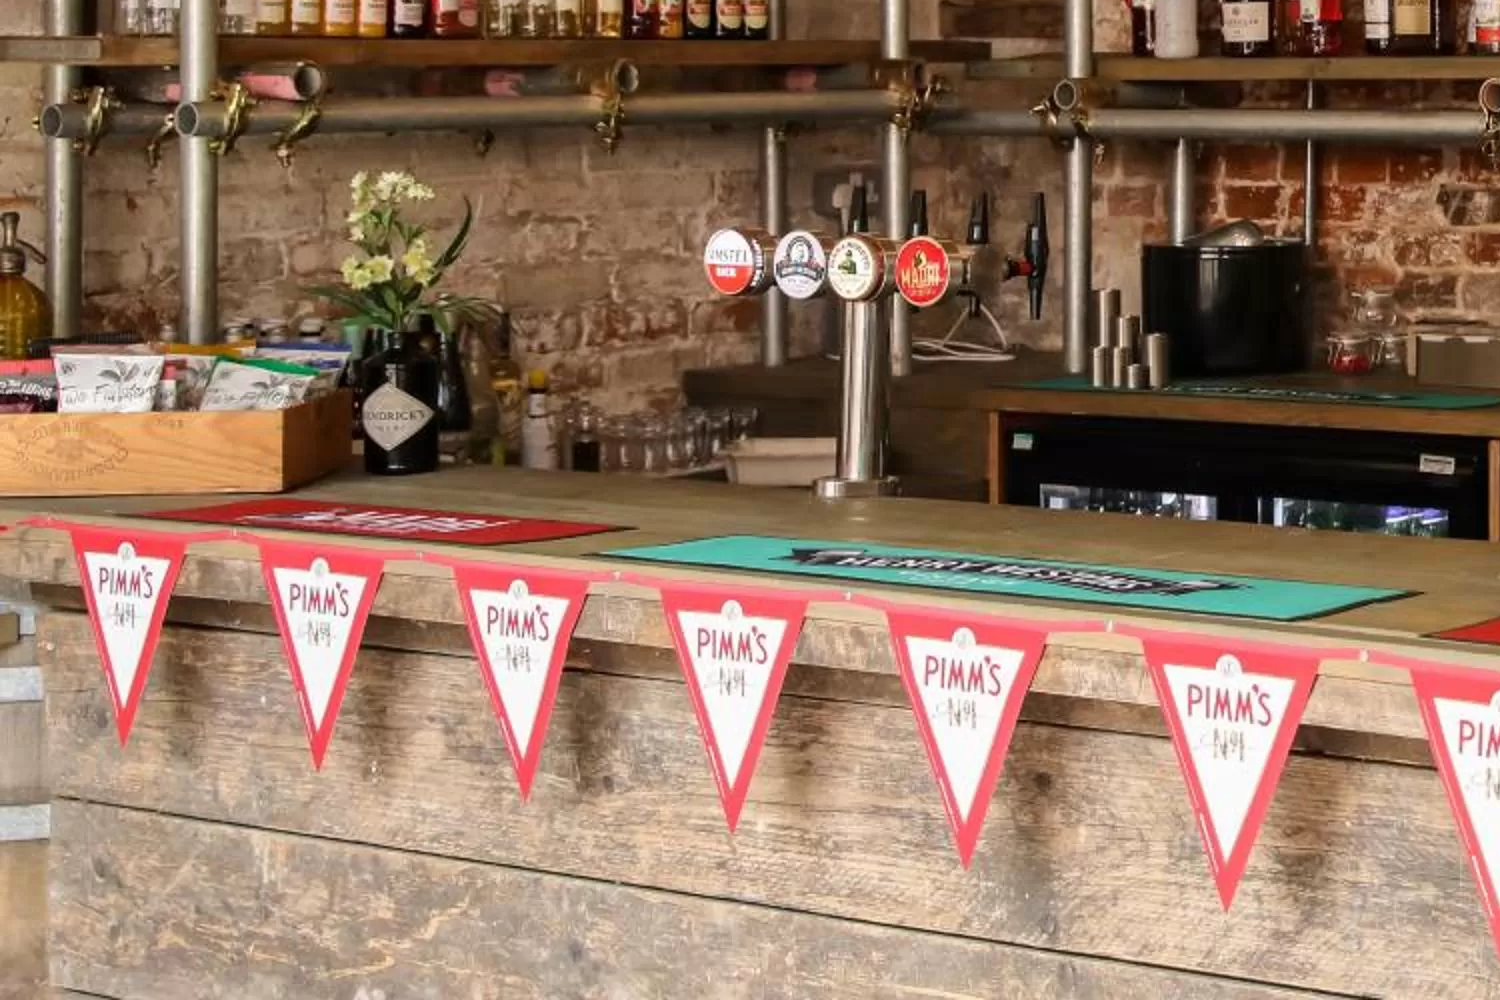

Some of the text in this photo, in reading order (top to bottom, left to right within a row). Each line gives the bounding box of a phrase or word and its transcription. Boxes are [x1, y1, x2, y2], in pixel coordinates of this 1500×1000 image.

[99, 565, 153, 598] PIMM'S
[289, 582, 349, 617] PIMM'S
[487, 605, 549, 641] PIMM'S
[697, 625, 769, 664] PIMM'S
[924, 655, 1001, 696] PIMM'S
[1187, 683, 1272, 727] PIMM'S
